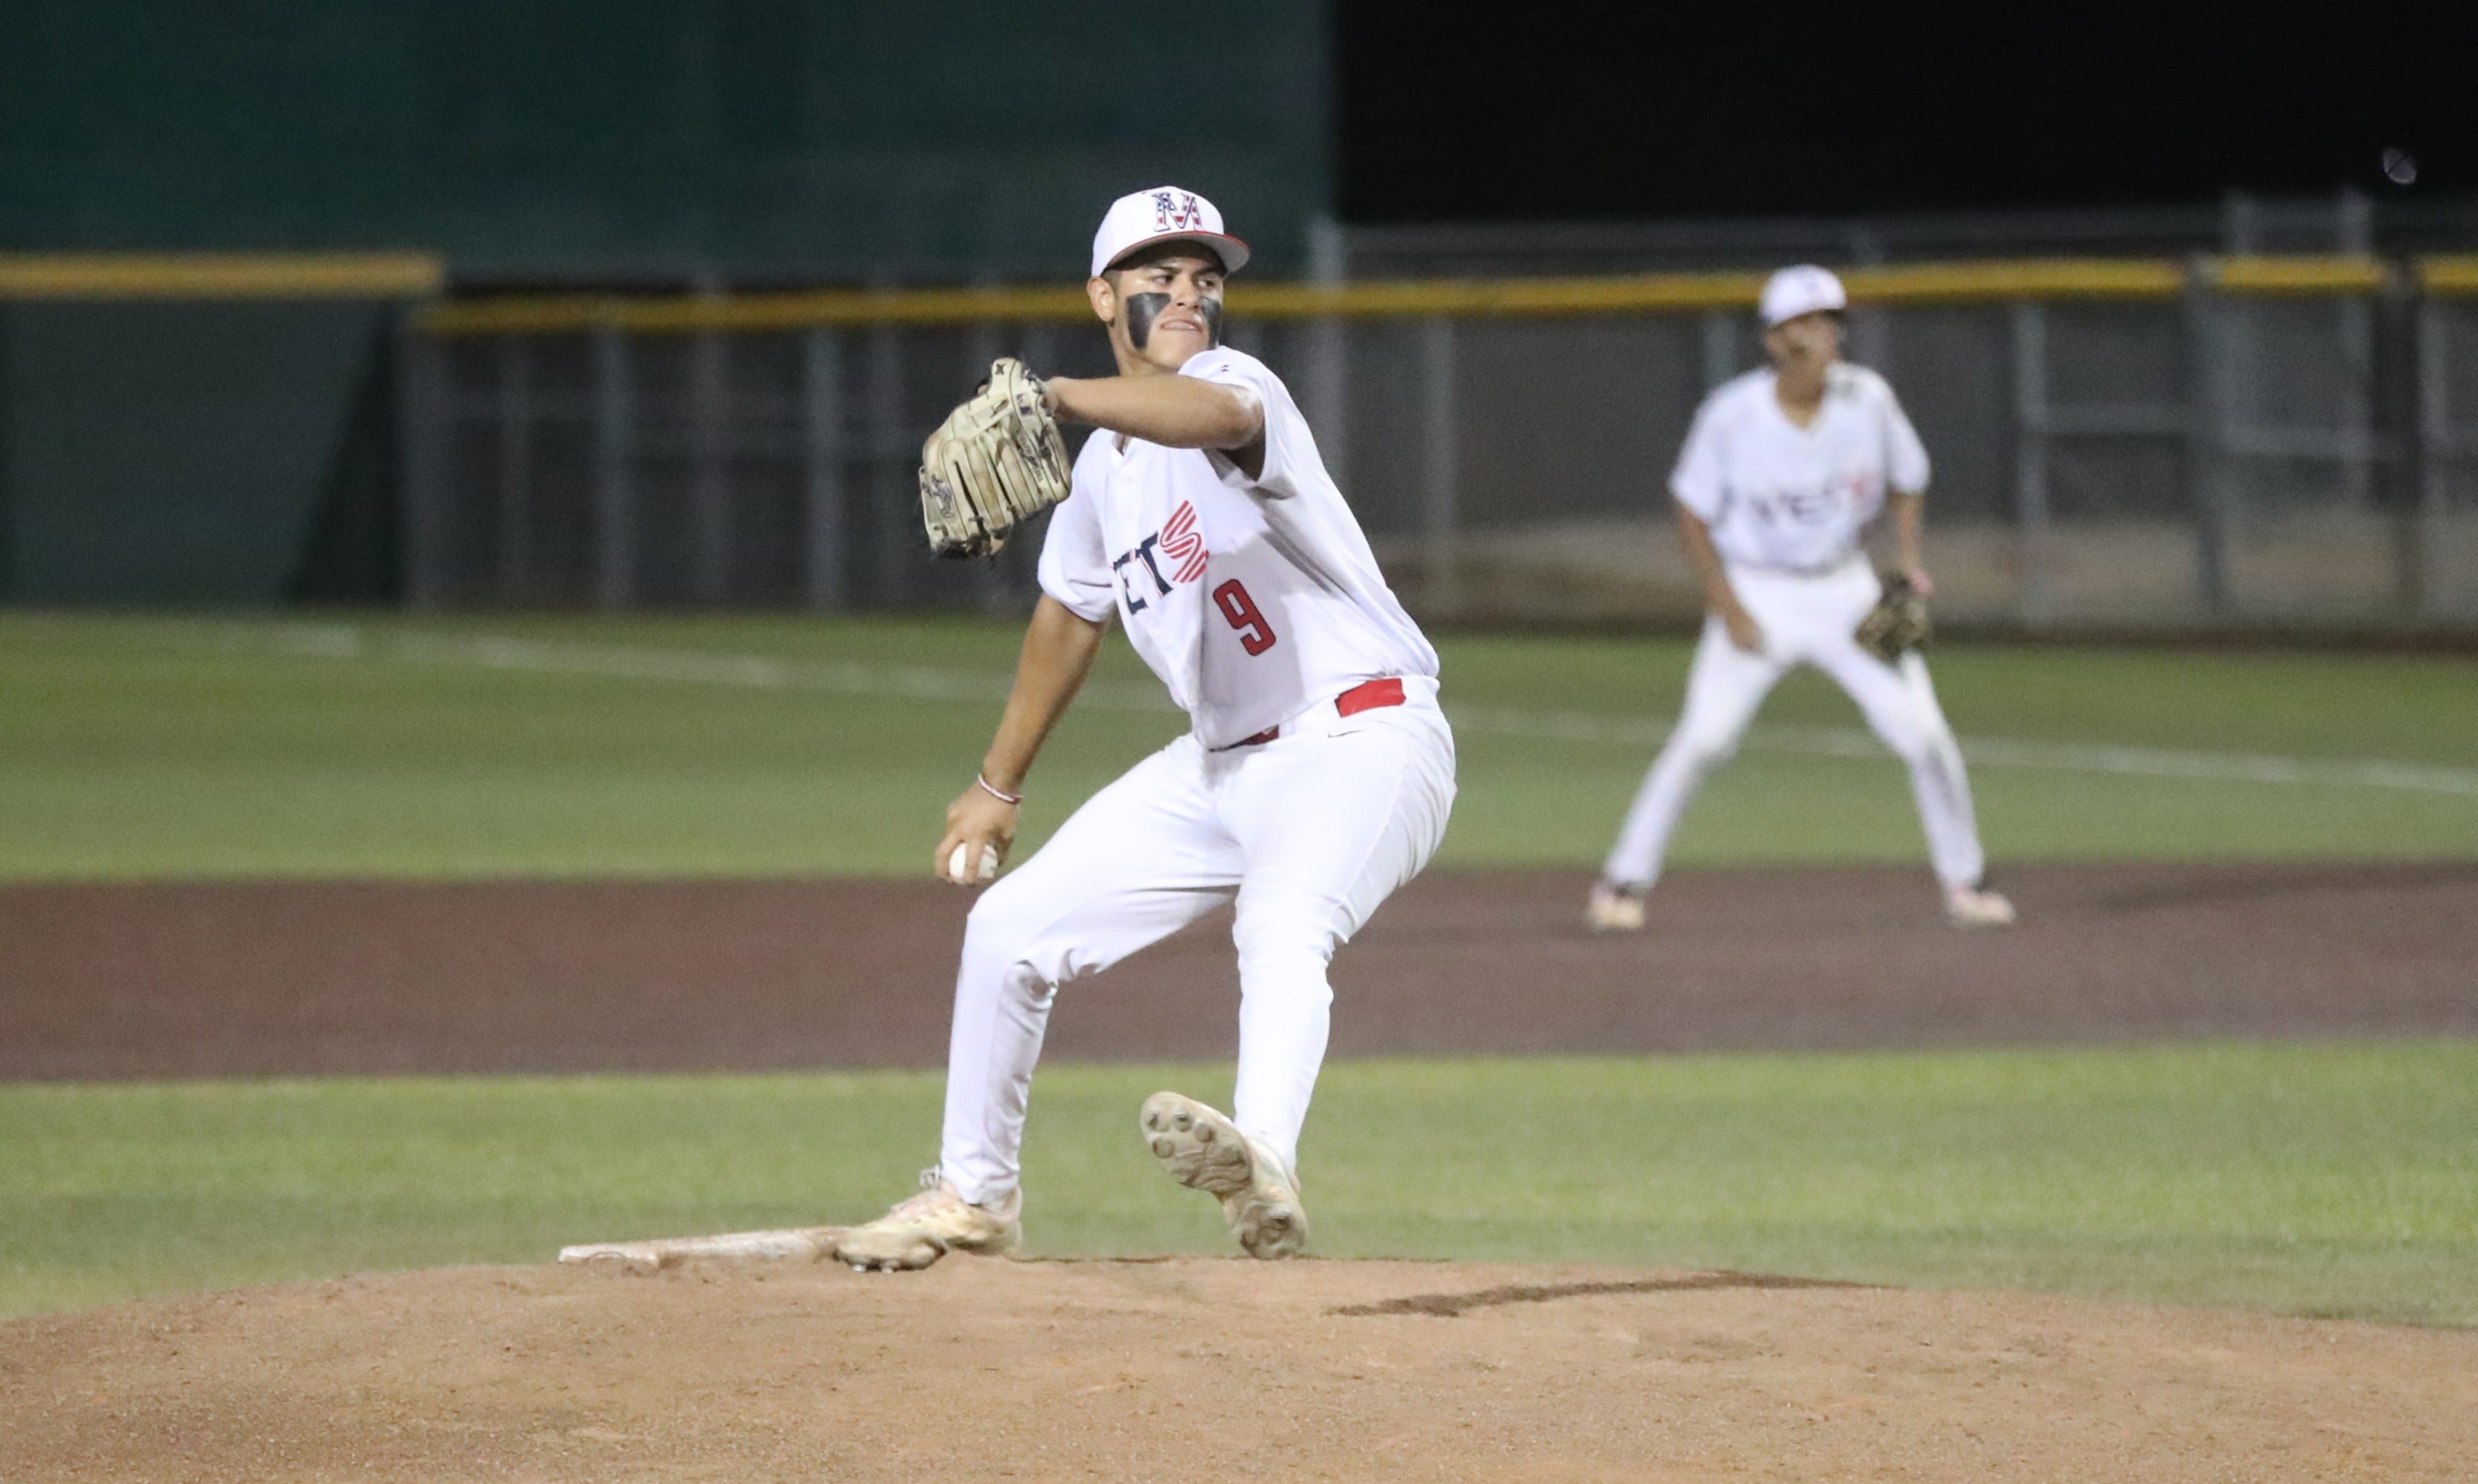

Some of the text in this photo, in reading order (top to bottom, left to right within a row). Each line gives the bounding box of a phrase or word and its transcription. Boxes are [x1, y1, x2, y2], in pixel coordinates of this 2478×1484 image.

[1152, 192, 1203, 231] M
[1113, 500, 1209, 616] ETS
[1212, 578, 1276, 656] 9
